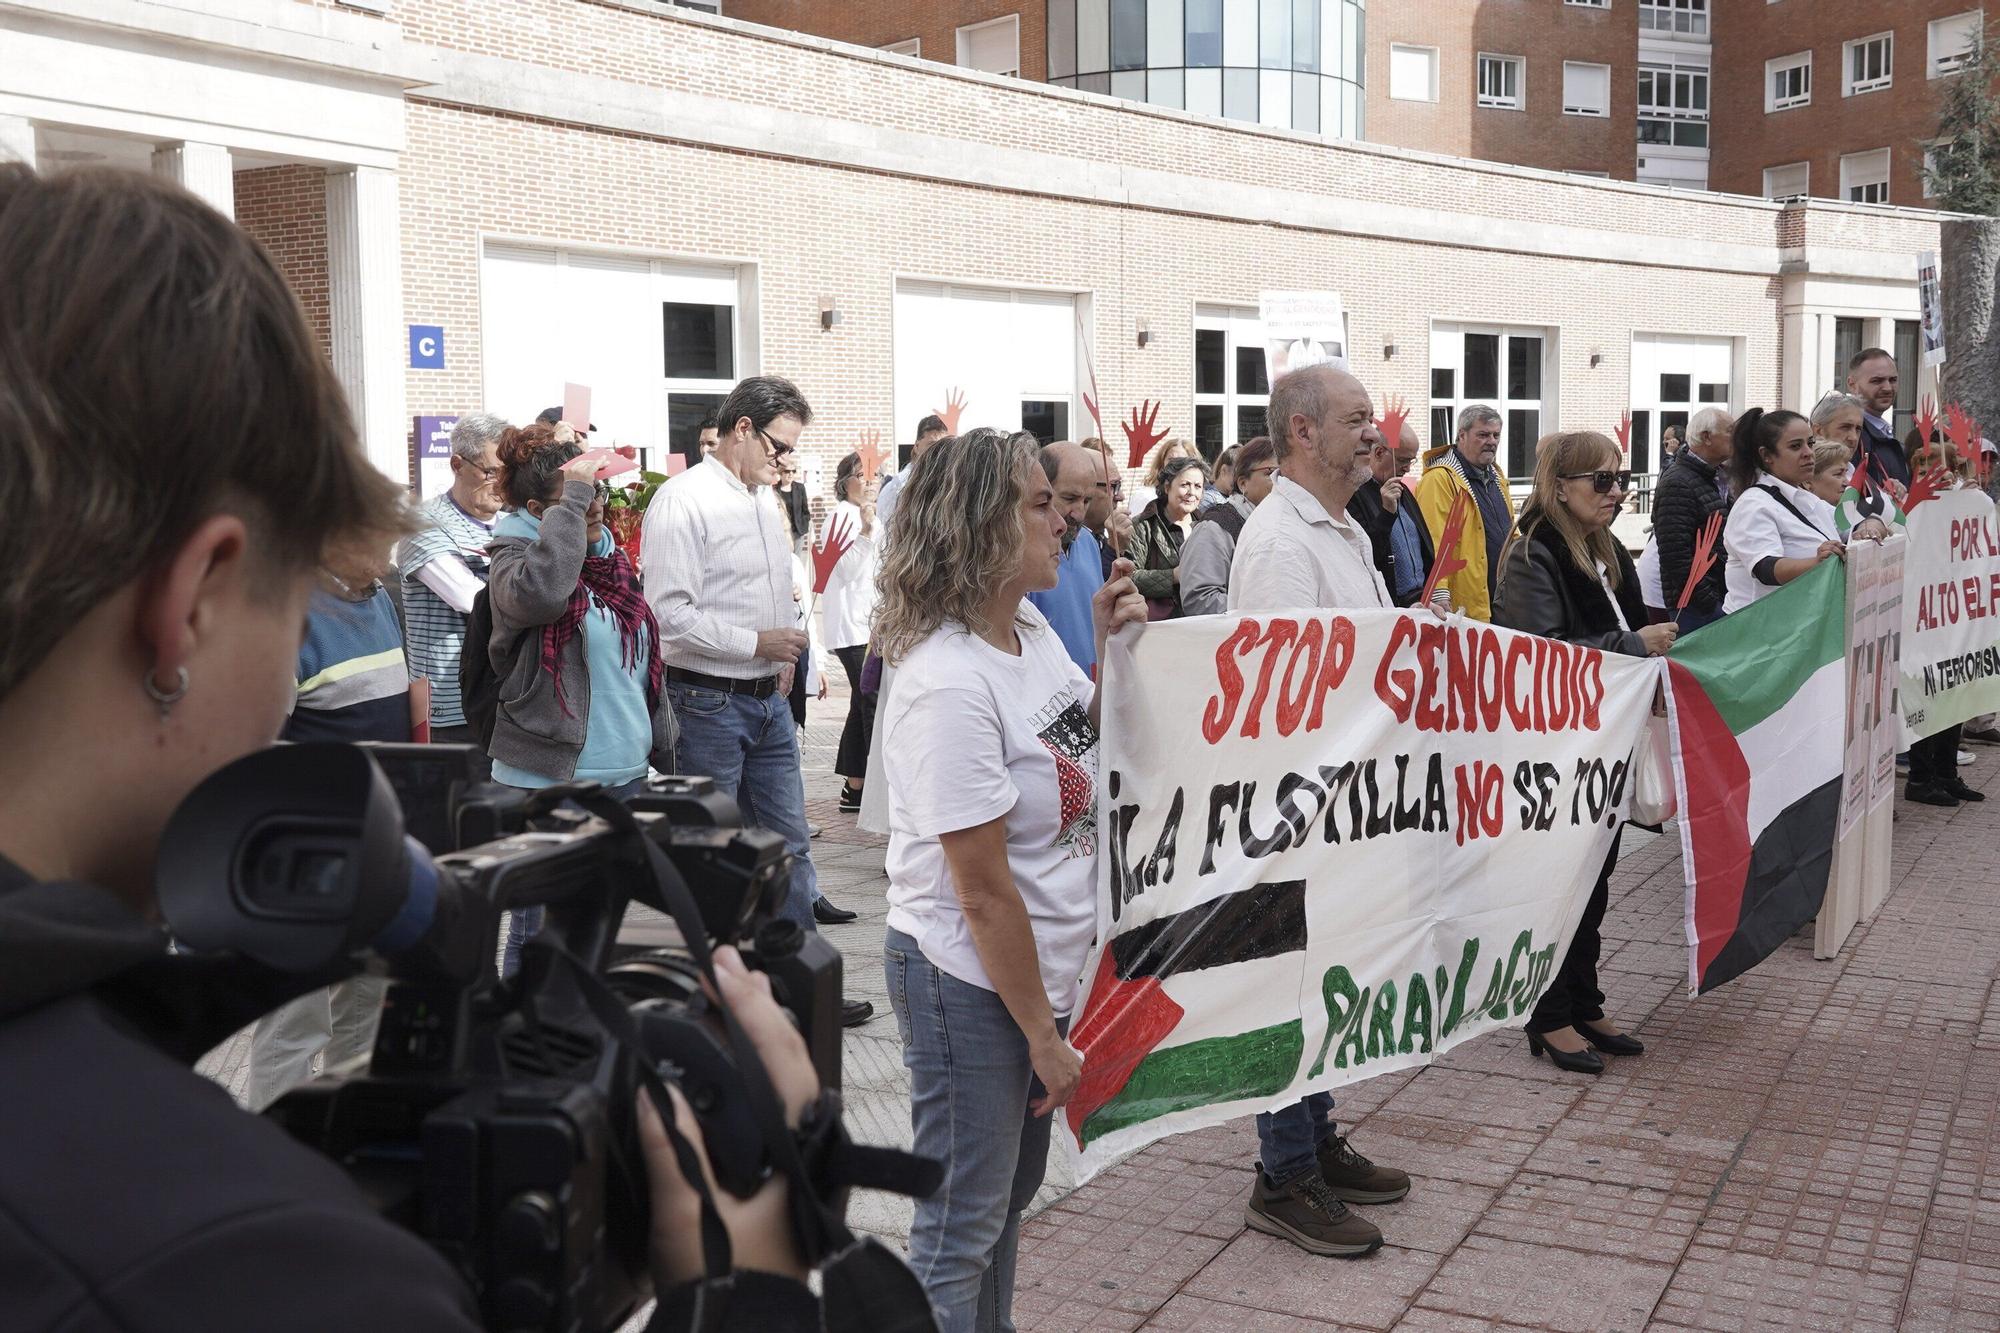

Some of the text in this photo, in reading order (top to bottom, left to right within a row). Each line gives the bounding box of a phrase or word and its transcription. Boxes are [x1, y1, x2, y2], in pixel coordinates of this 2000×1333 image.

[419, 337, 436, 357] C
[1950, 514, 2000, 563] POR L
[1916, 580, 1960, 633] ALTO
[1962, 575, 1987, 621] EL
[1201, 614, 1606, 746] STOP GENOCIDIO
[1923, 663, 1937, 699] NI
[1198, 752, 1450, 876] FLOTILLA
[1454, 760, 1505, 848] NO
[1513, 760, 1561, 832] SE
